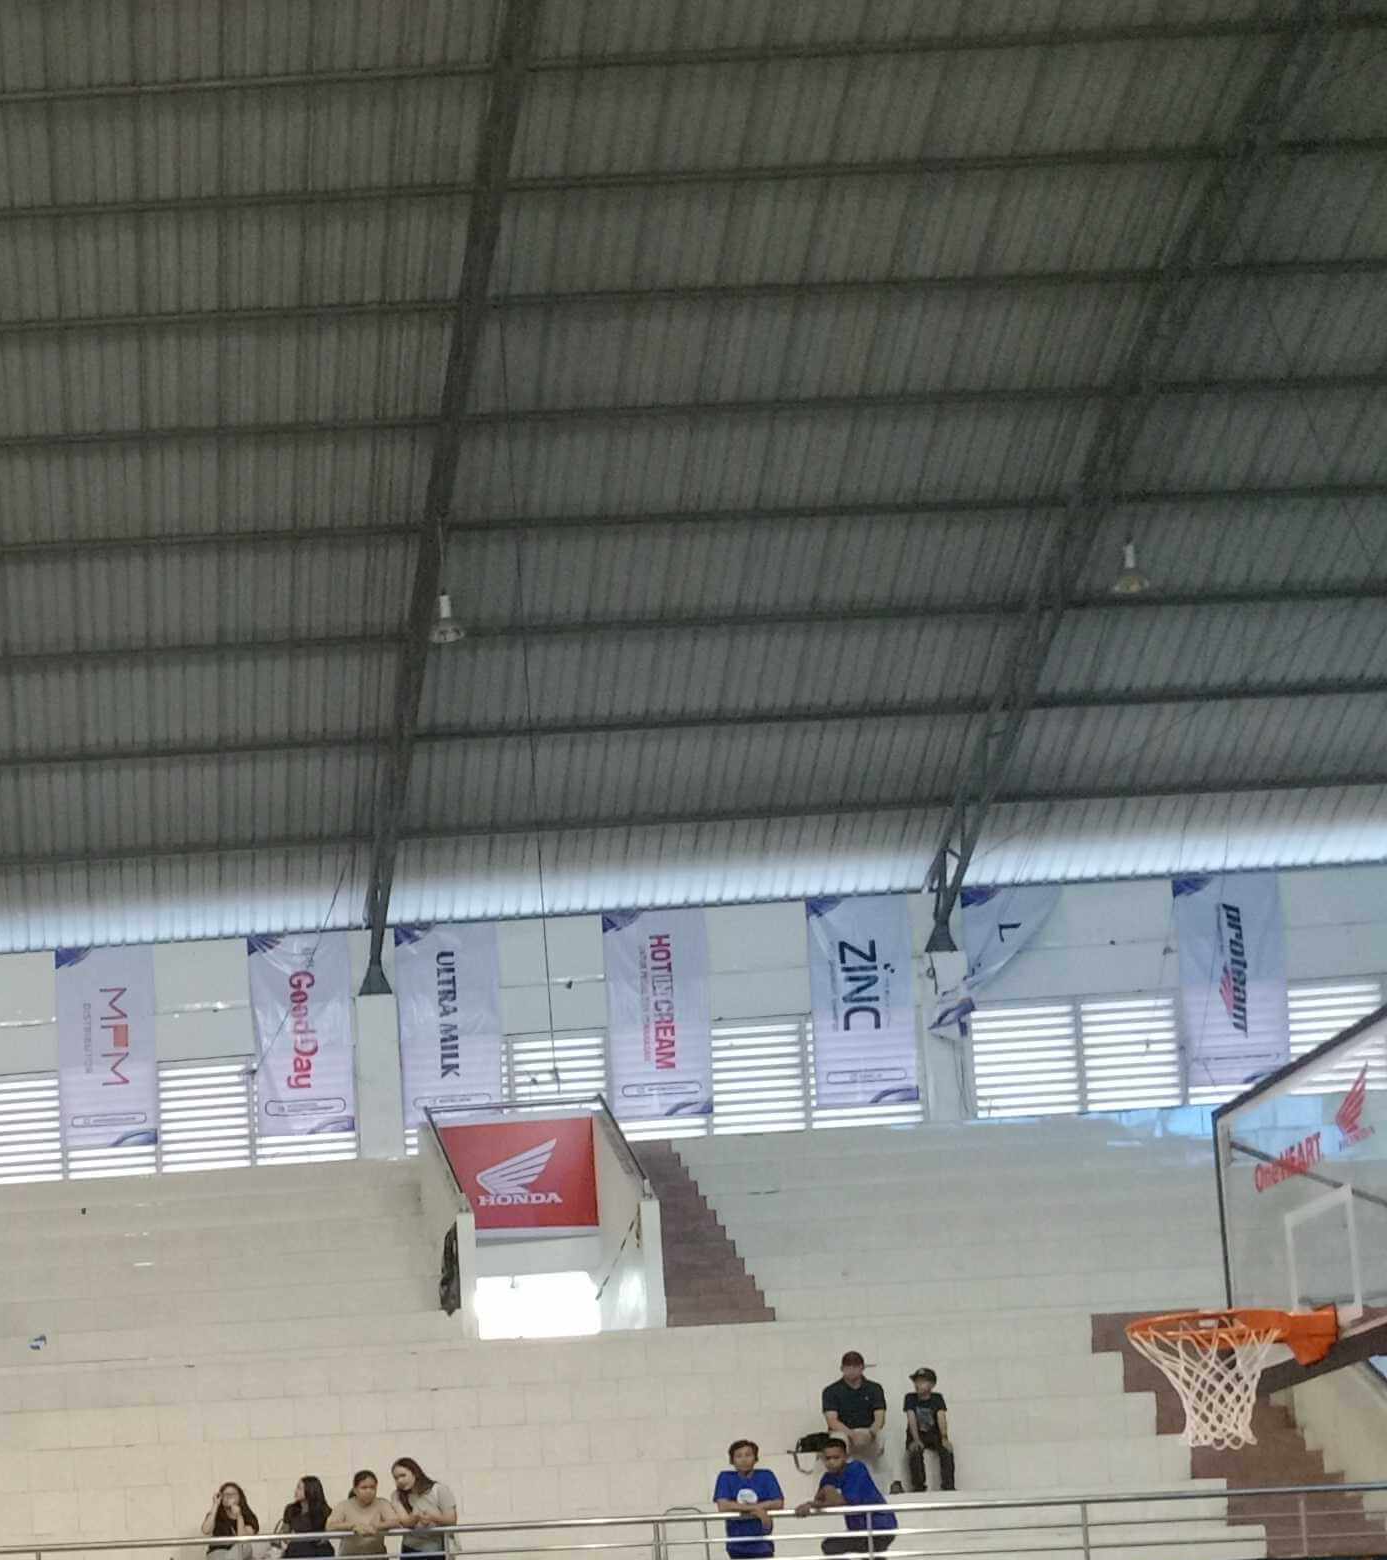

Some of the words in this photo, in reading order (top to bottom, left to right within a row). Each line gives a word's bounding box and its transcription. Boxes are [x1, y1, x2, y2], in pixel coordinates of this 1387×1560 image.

[435, 952, 458, 1016] ULTRA
[838, 940, 895, 1031] ZINC
[439, 1023, 461, 1079] MILK
[477, 1191, 564, 1207] HONDA
